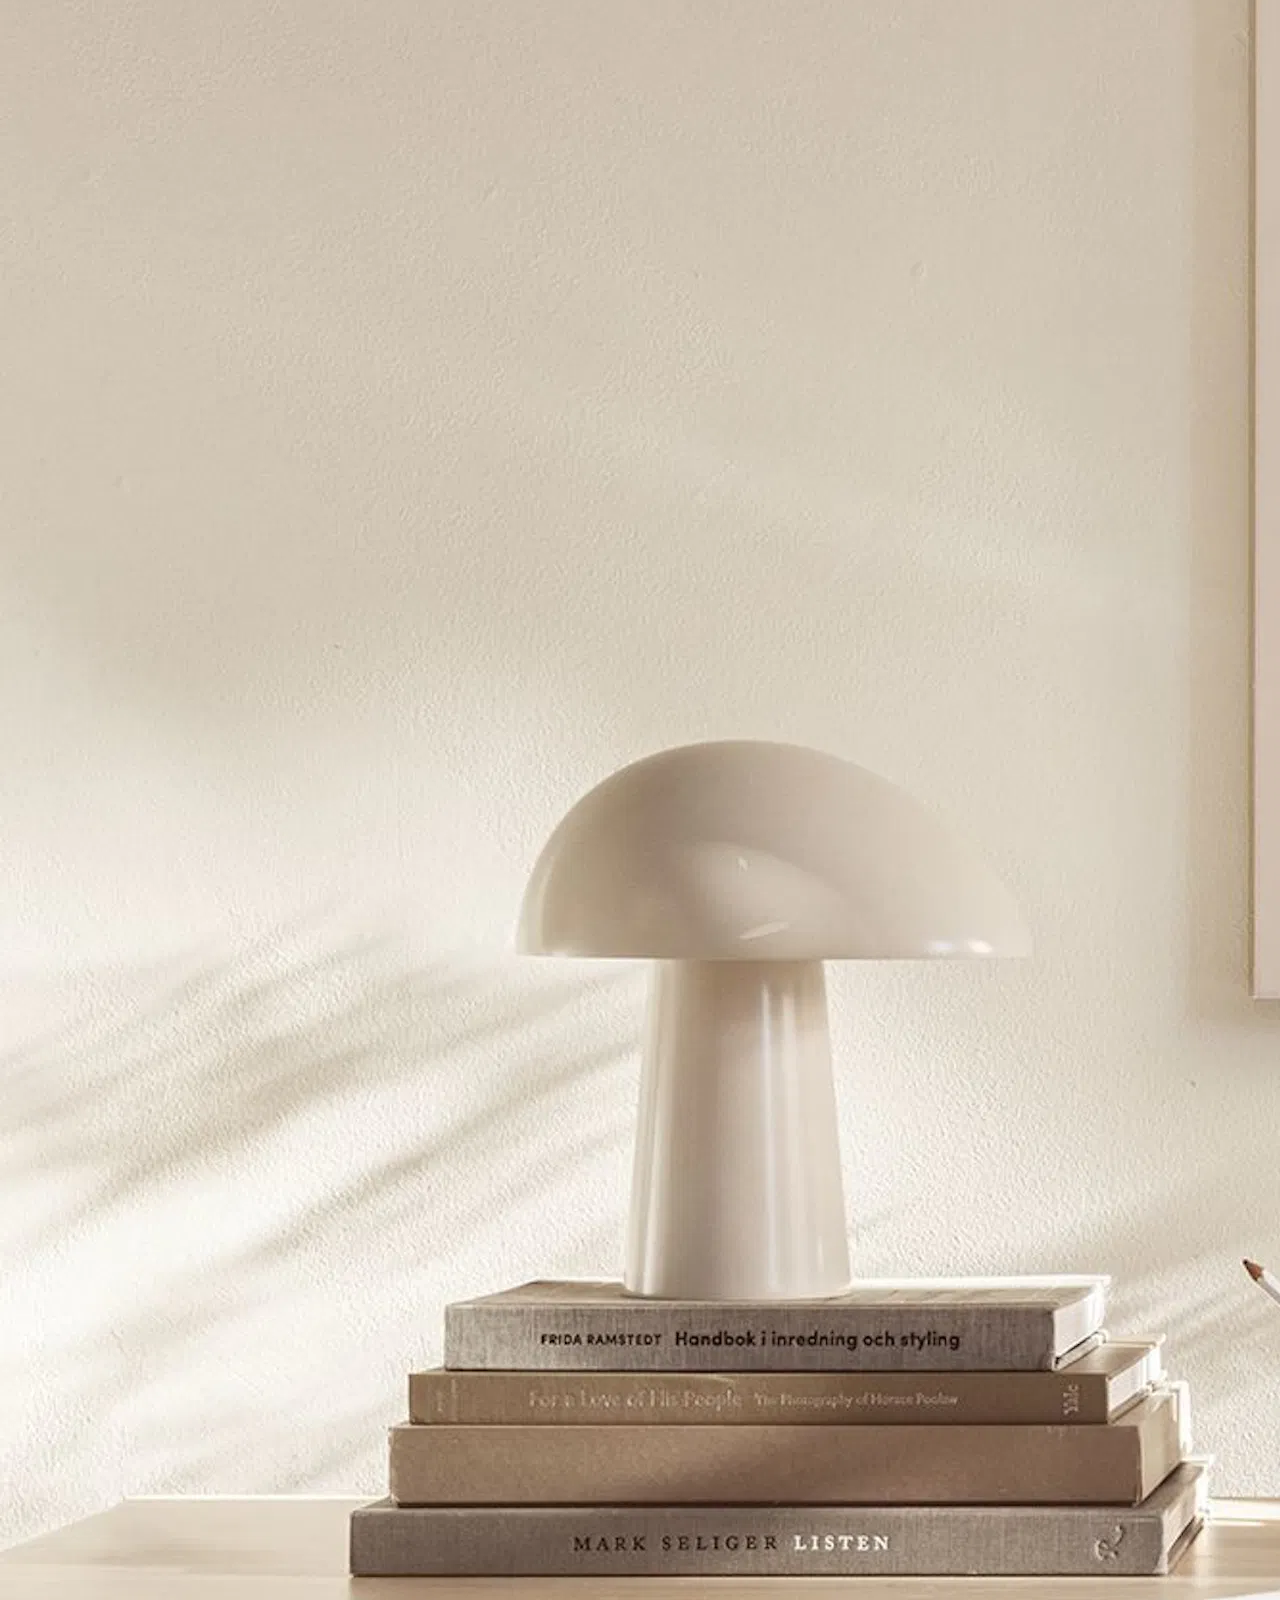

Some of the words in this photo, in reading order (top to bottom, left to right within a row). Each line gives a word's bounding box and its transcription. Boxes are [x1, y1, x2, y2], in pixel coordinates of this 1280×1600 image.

[541, 1333, 583, 1346] FRIDA
[586, 1333, 662, 1346] RAMSTEDT
[675, 1330, 757, 1347] Handbok
[761, 1330, 767, 1347] i
[771, 1330, 858, 1351] inredning
[862, 1330, 895, 1347] och
[900, 1330, 961, 1351] styling
[573, 1535, 647, 1551] MARK
[661, 1535, 779, 1551] SELIGER
[793, 1534, 891, 1551] LISTEN
